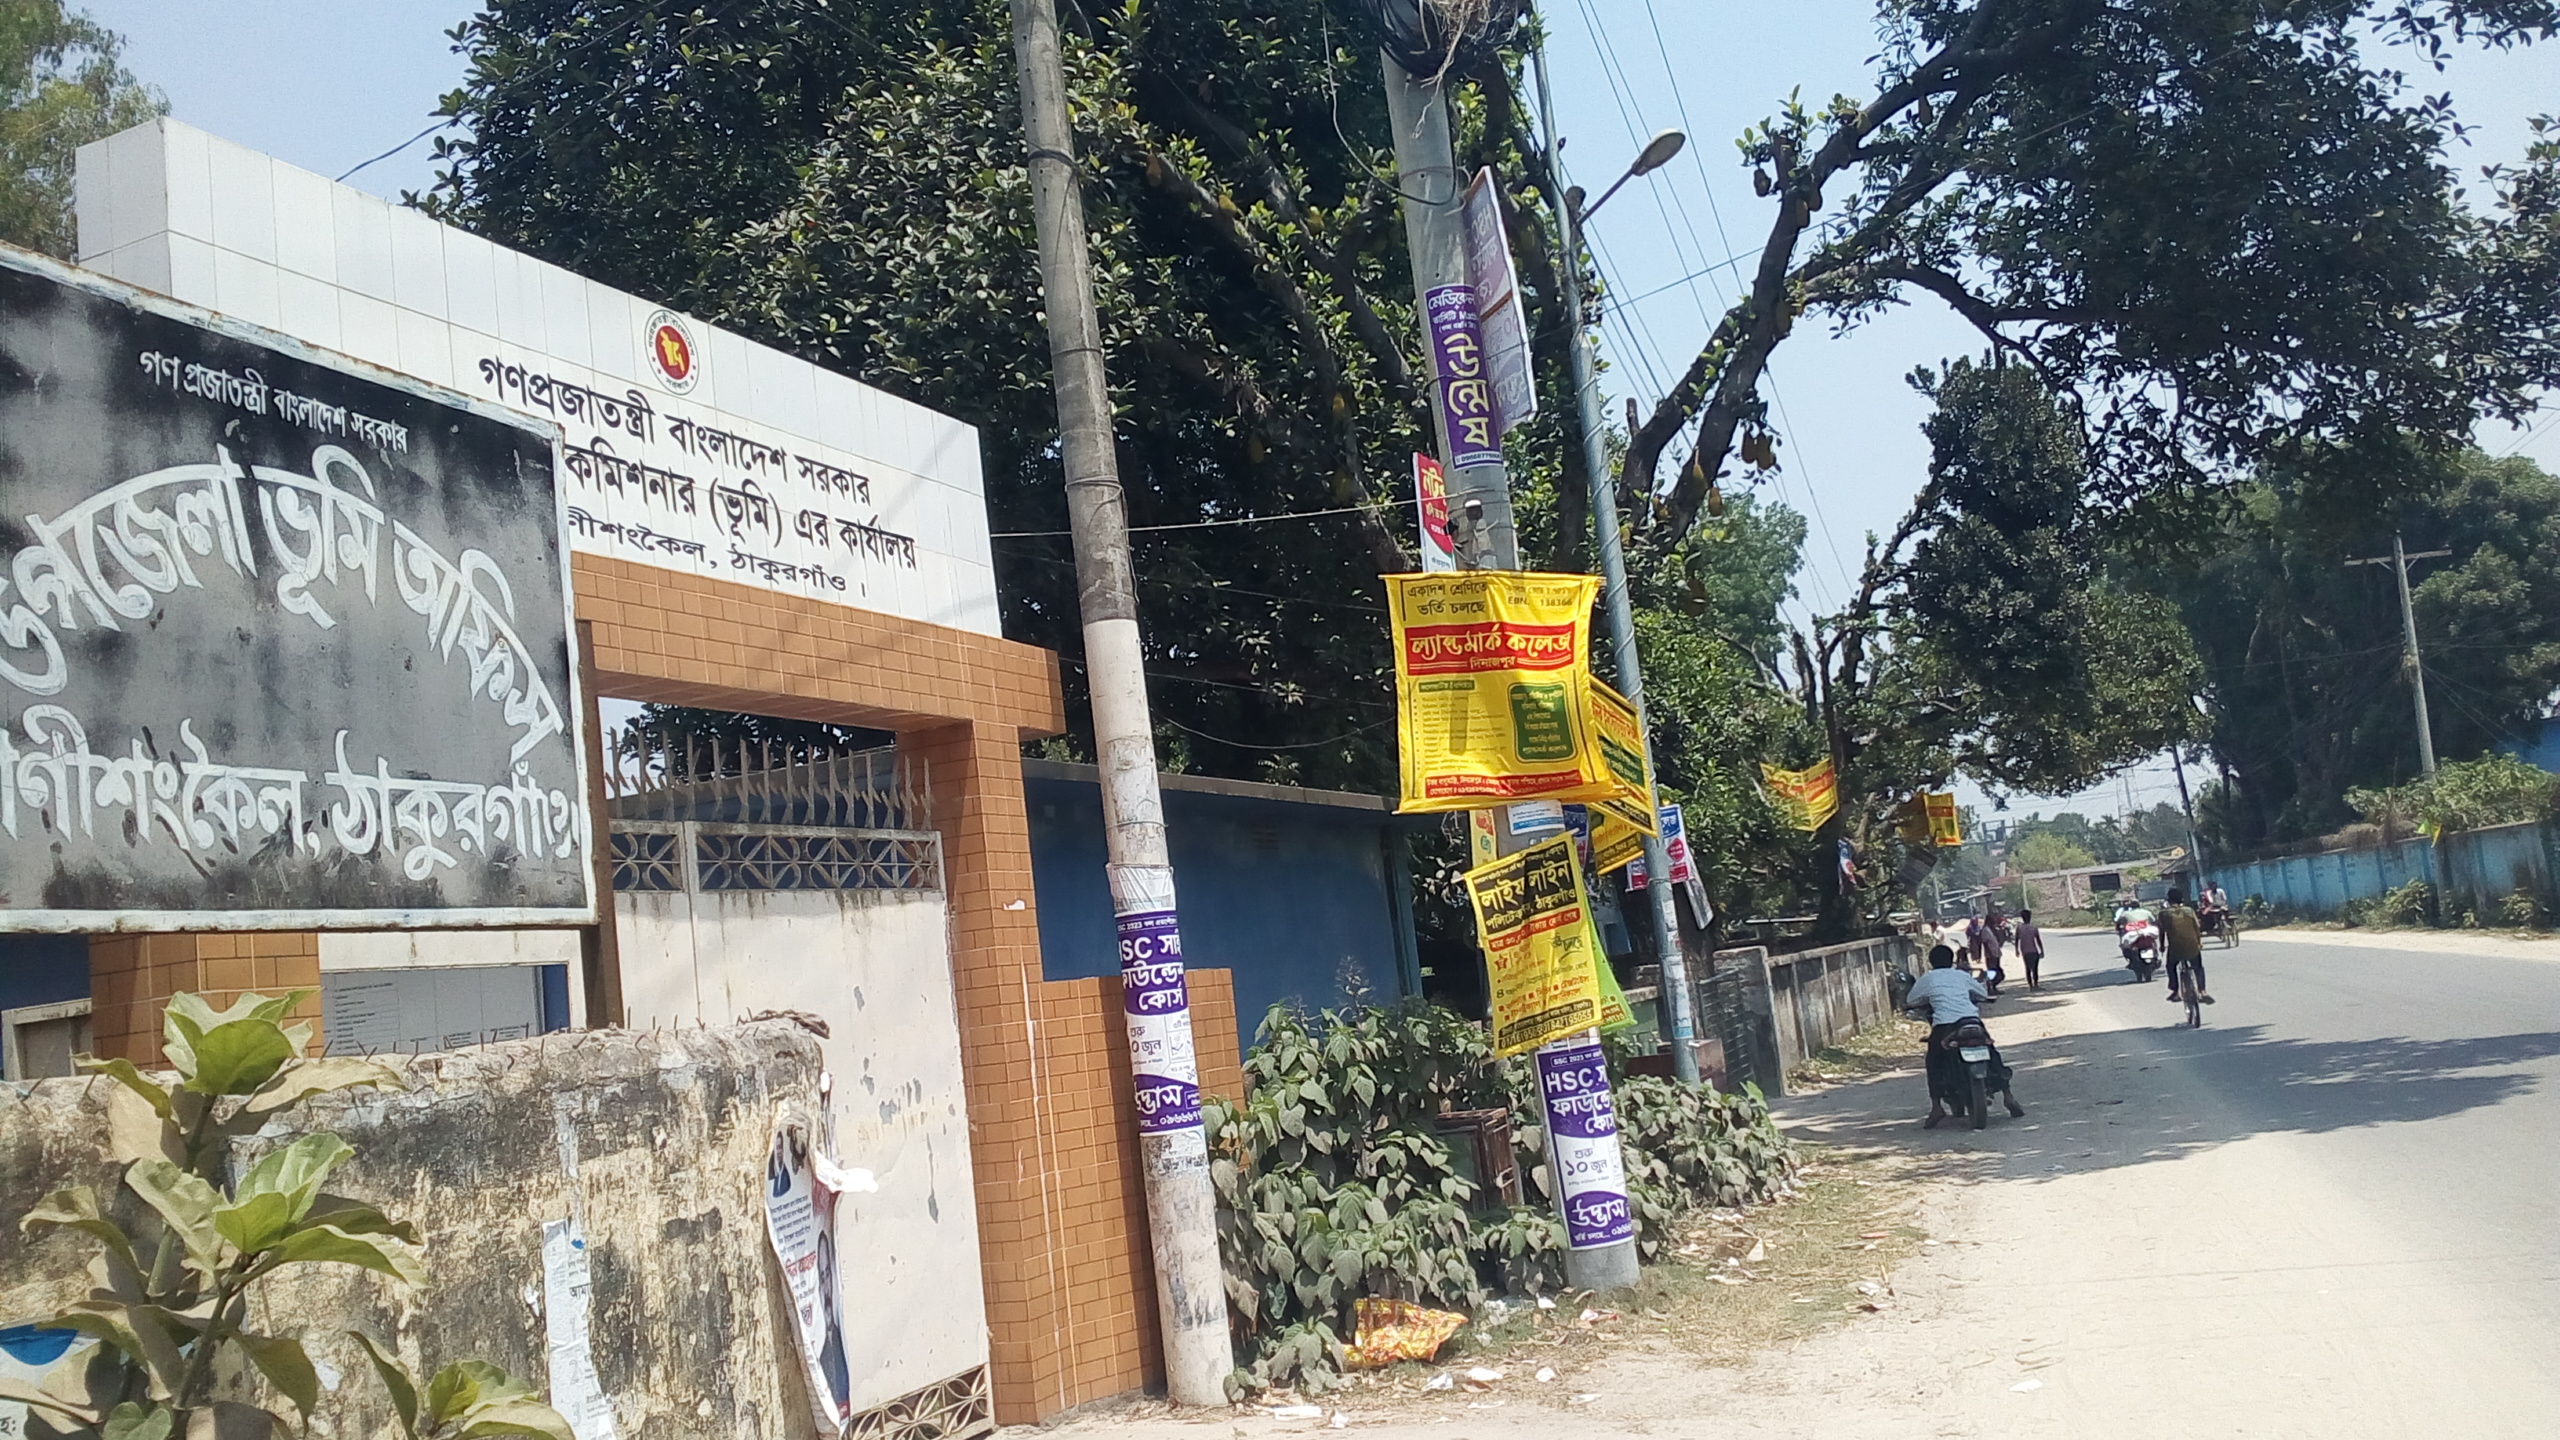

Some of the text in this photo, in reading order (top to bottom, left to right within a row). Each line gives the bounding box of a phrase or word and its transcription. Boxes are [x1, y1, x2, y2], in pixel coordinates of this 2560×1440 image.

[139, 350, 180, 390] গণ
[272, 388, 347, 437] বাংলাদেশ
[350, 409, 409, 454] সরকার
[479, 354, 871, 507] গণপ্রজাতন্ত্রী বাংলাদেশ সরকার
[565, 436, 917, 571] কমিশনার (ভূমি) এর কার্যালয়
[727, 543, 848, 593] ঠাকুরগাঁও
[1408, 580, 1489, 597] একাদশ শ্রেণিতে
[251, 444, 386, 628] ভূমি
[393, 519, 565, 770] অফিস
[1416, 599, 1486, 616] ভর্তি চলছে
[1504, 631, 1572, 658] কলেজ
[1469, 655, 1516, 670] দিনাজপুর
[1527, 860, 1570, 892] লাইন
[1118, 936, 1153, 961] SC
[1138, 980, 1184, 1010] কোর্স
[1141, 1040, 1161, 1055] জুন
[1545, 1068, 1594, 1093] HSC
[1550, 1089, 1611, 1117] ফাউন্ডে
[1574, 1147, 1594, 1159] শুরু
[1565, 1159, 1608, 1176] ১০ জুন
[1570, 1198, 1625, 1228] উদ্ভাস
